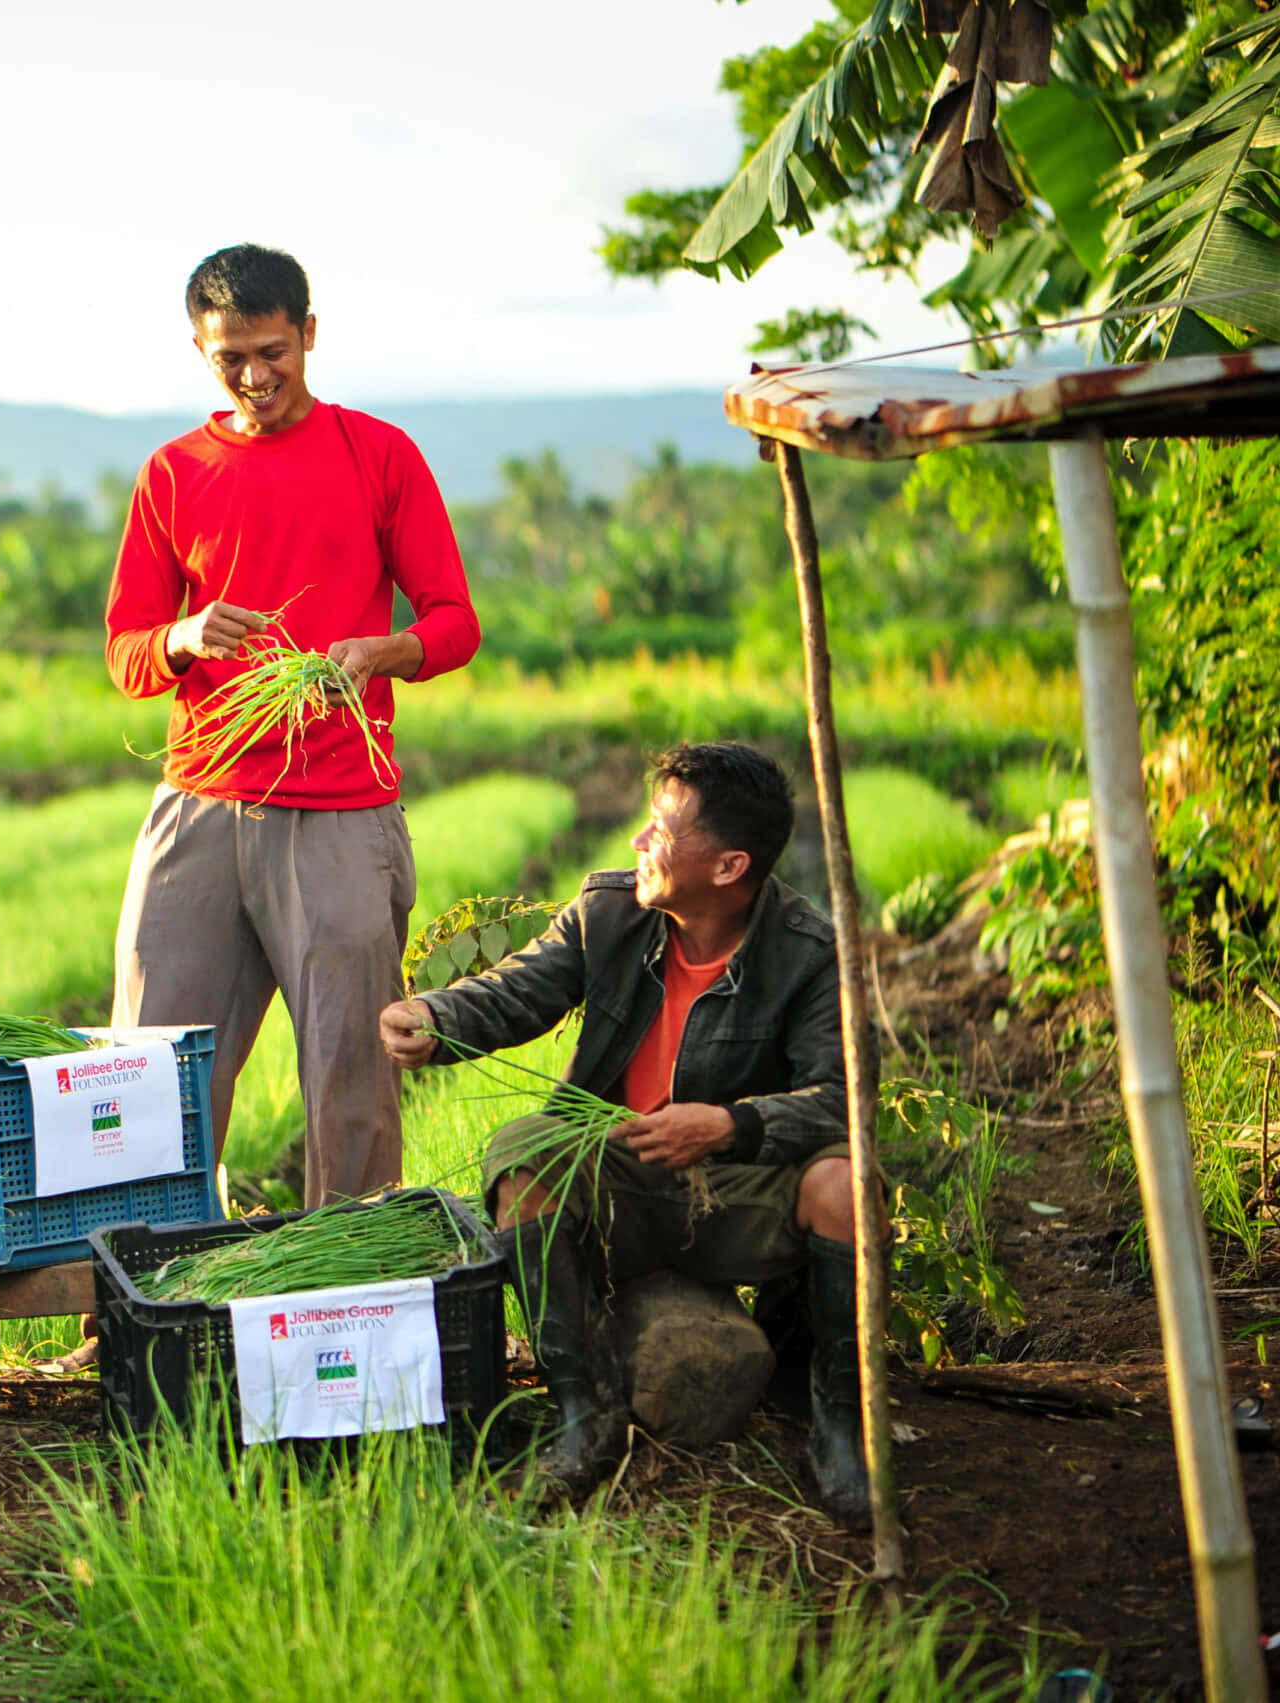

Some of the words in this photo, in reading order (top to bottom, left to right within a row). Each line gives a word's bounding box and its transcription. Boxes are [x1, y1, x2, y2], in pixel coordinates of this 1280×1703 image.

[71, 1063, 113, 1078] Jollibee
[114, 1057, 147, 1071] Group
[73, 1070, 142, 1091] FOUNDATION
[93, 1131, 122, 1142] Farmer
[289, 1308, 345, 1325] Jollibee
[348, 1304, 395, 1319] Group
[291, 1319, 384, 1337] FOUNDATION
[318, 1382, 357, 1393] Farmer
